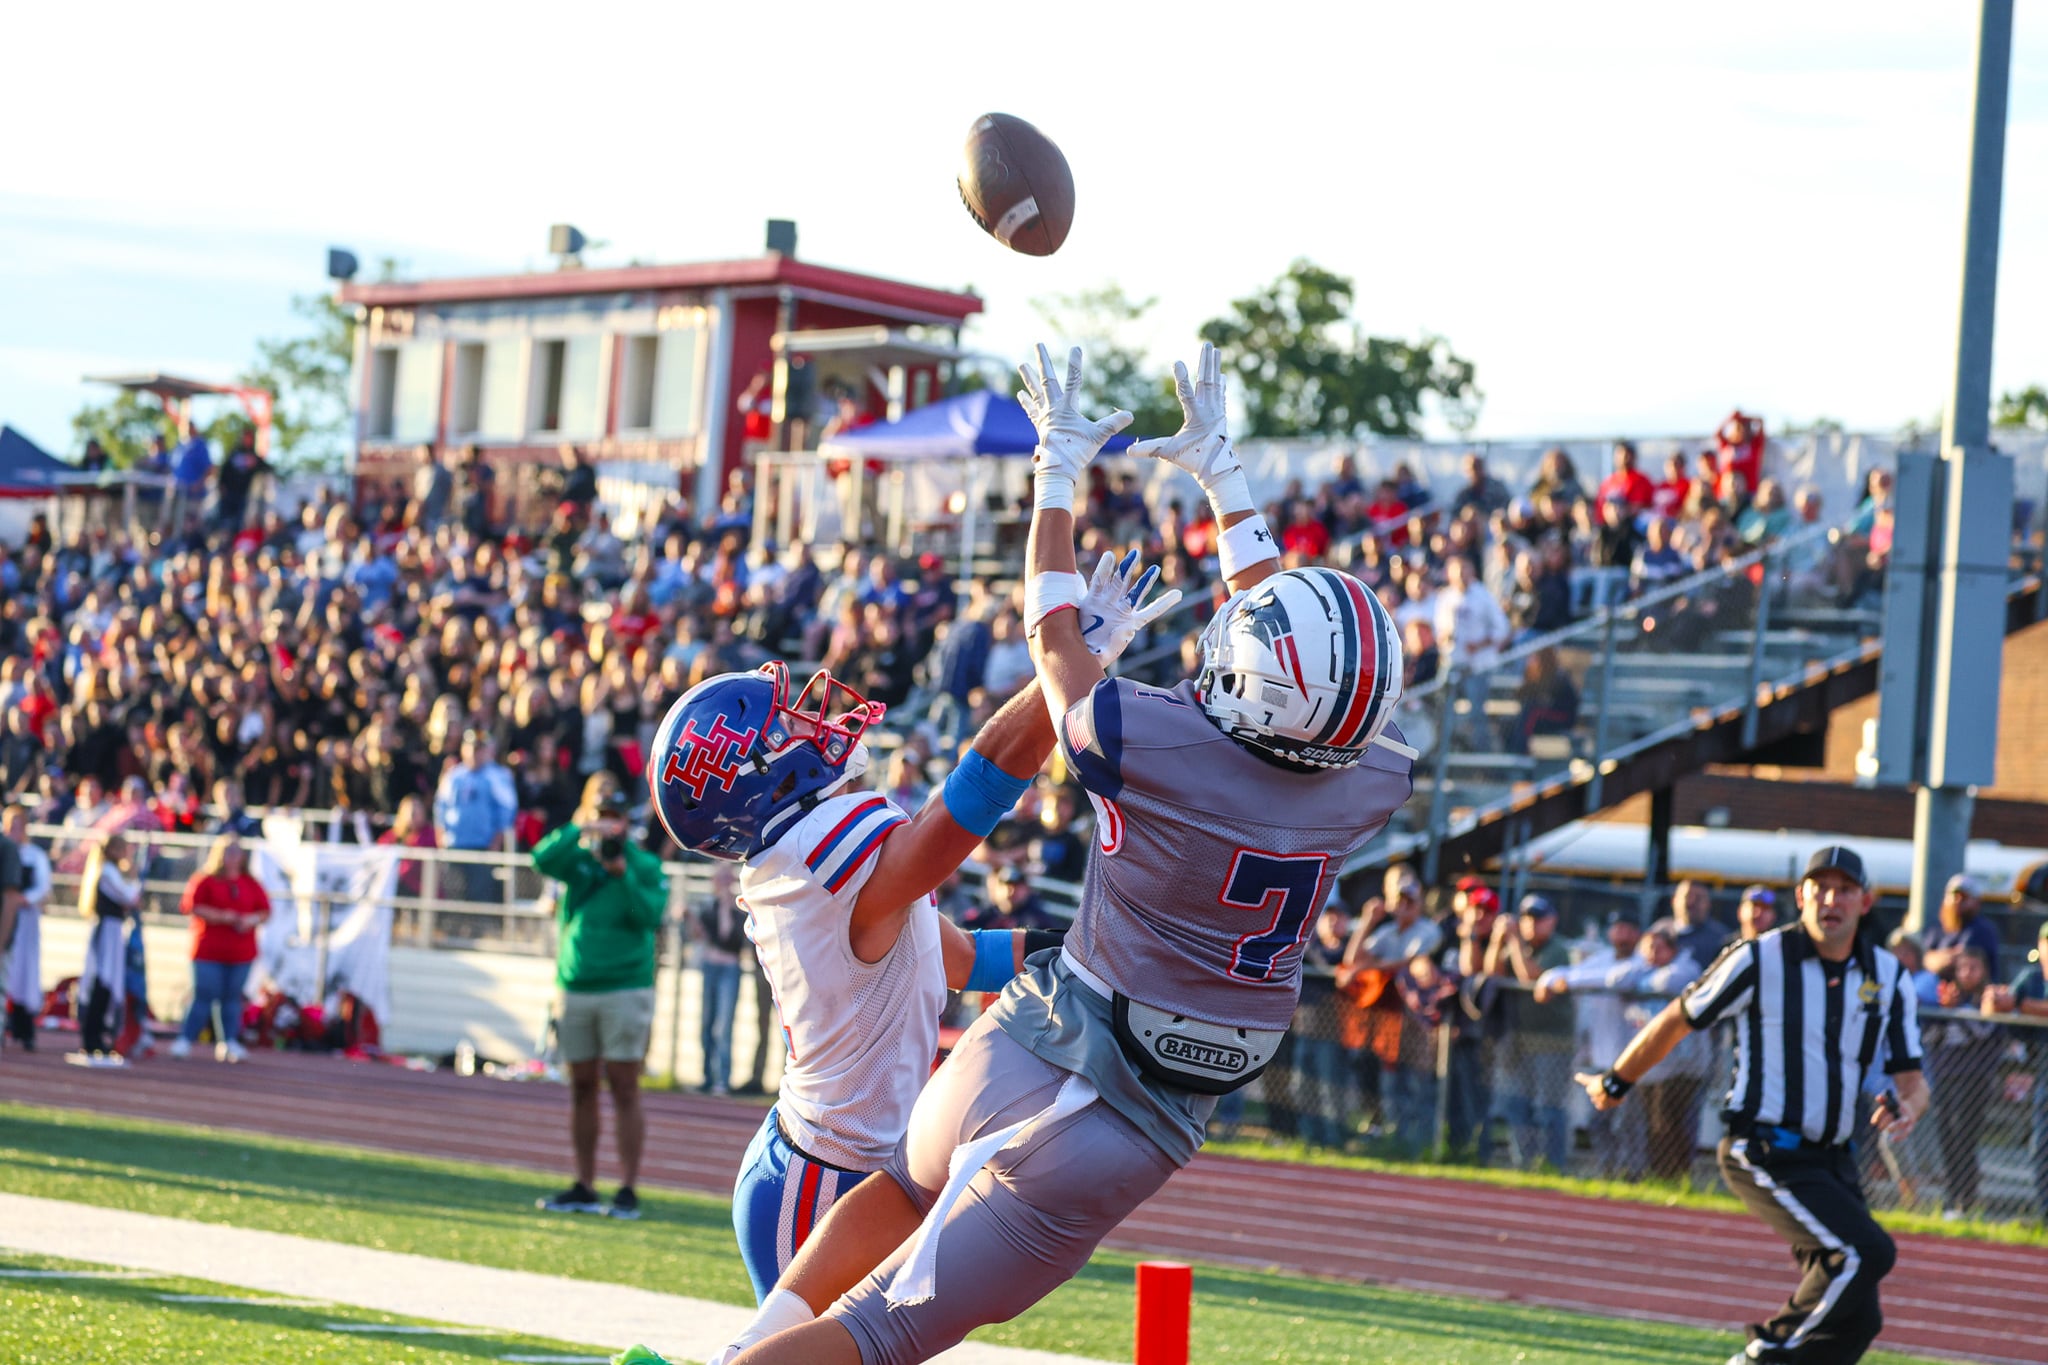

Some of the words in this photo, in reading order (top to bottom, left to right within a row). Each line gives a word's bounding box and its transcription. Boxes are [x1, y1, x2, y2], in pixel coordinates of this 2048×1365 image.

[1264, 710, 1274, 726] 7
[1218, 847, 1331, 982] 7
[1163, 1038, 1242, 1069] BATTLE
